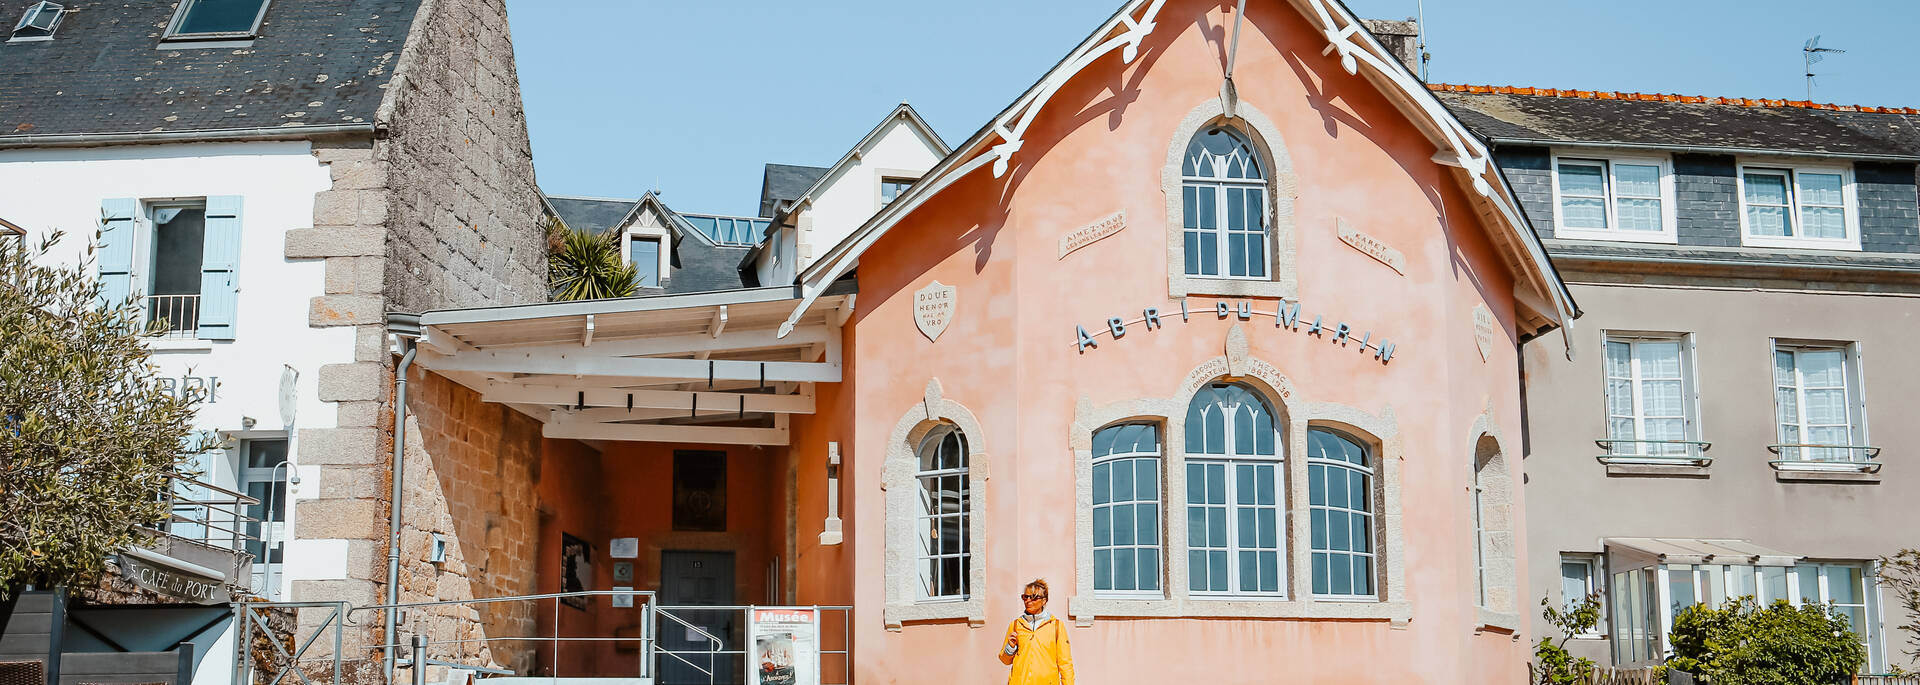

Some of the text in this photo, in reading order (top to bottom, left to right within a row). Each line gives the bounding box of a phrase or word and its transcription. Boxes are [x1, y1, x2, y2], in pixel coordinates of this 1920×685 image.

[920, 290, 948, 301] DOUE
[1076, 298, 1396, 366] ABRI DU MARIN
[140, 568, 170, 589] CAFÉ
[184, 580, 217, 600] PORT
[760, 611, 809, 622] Musée
